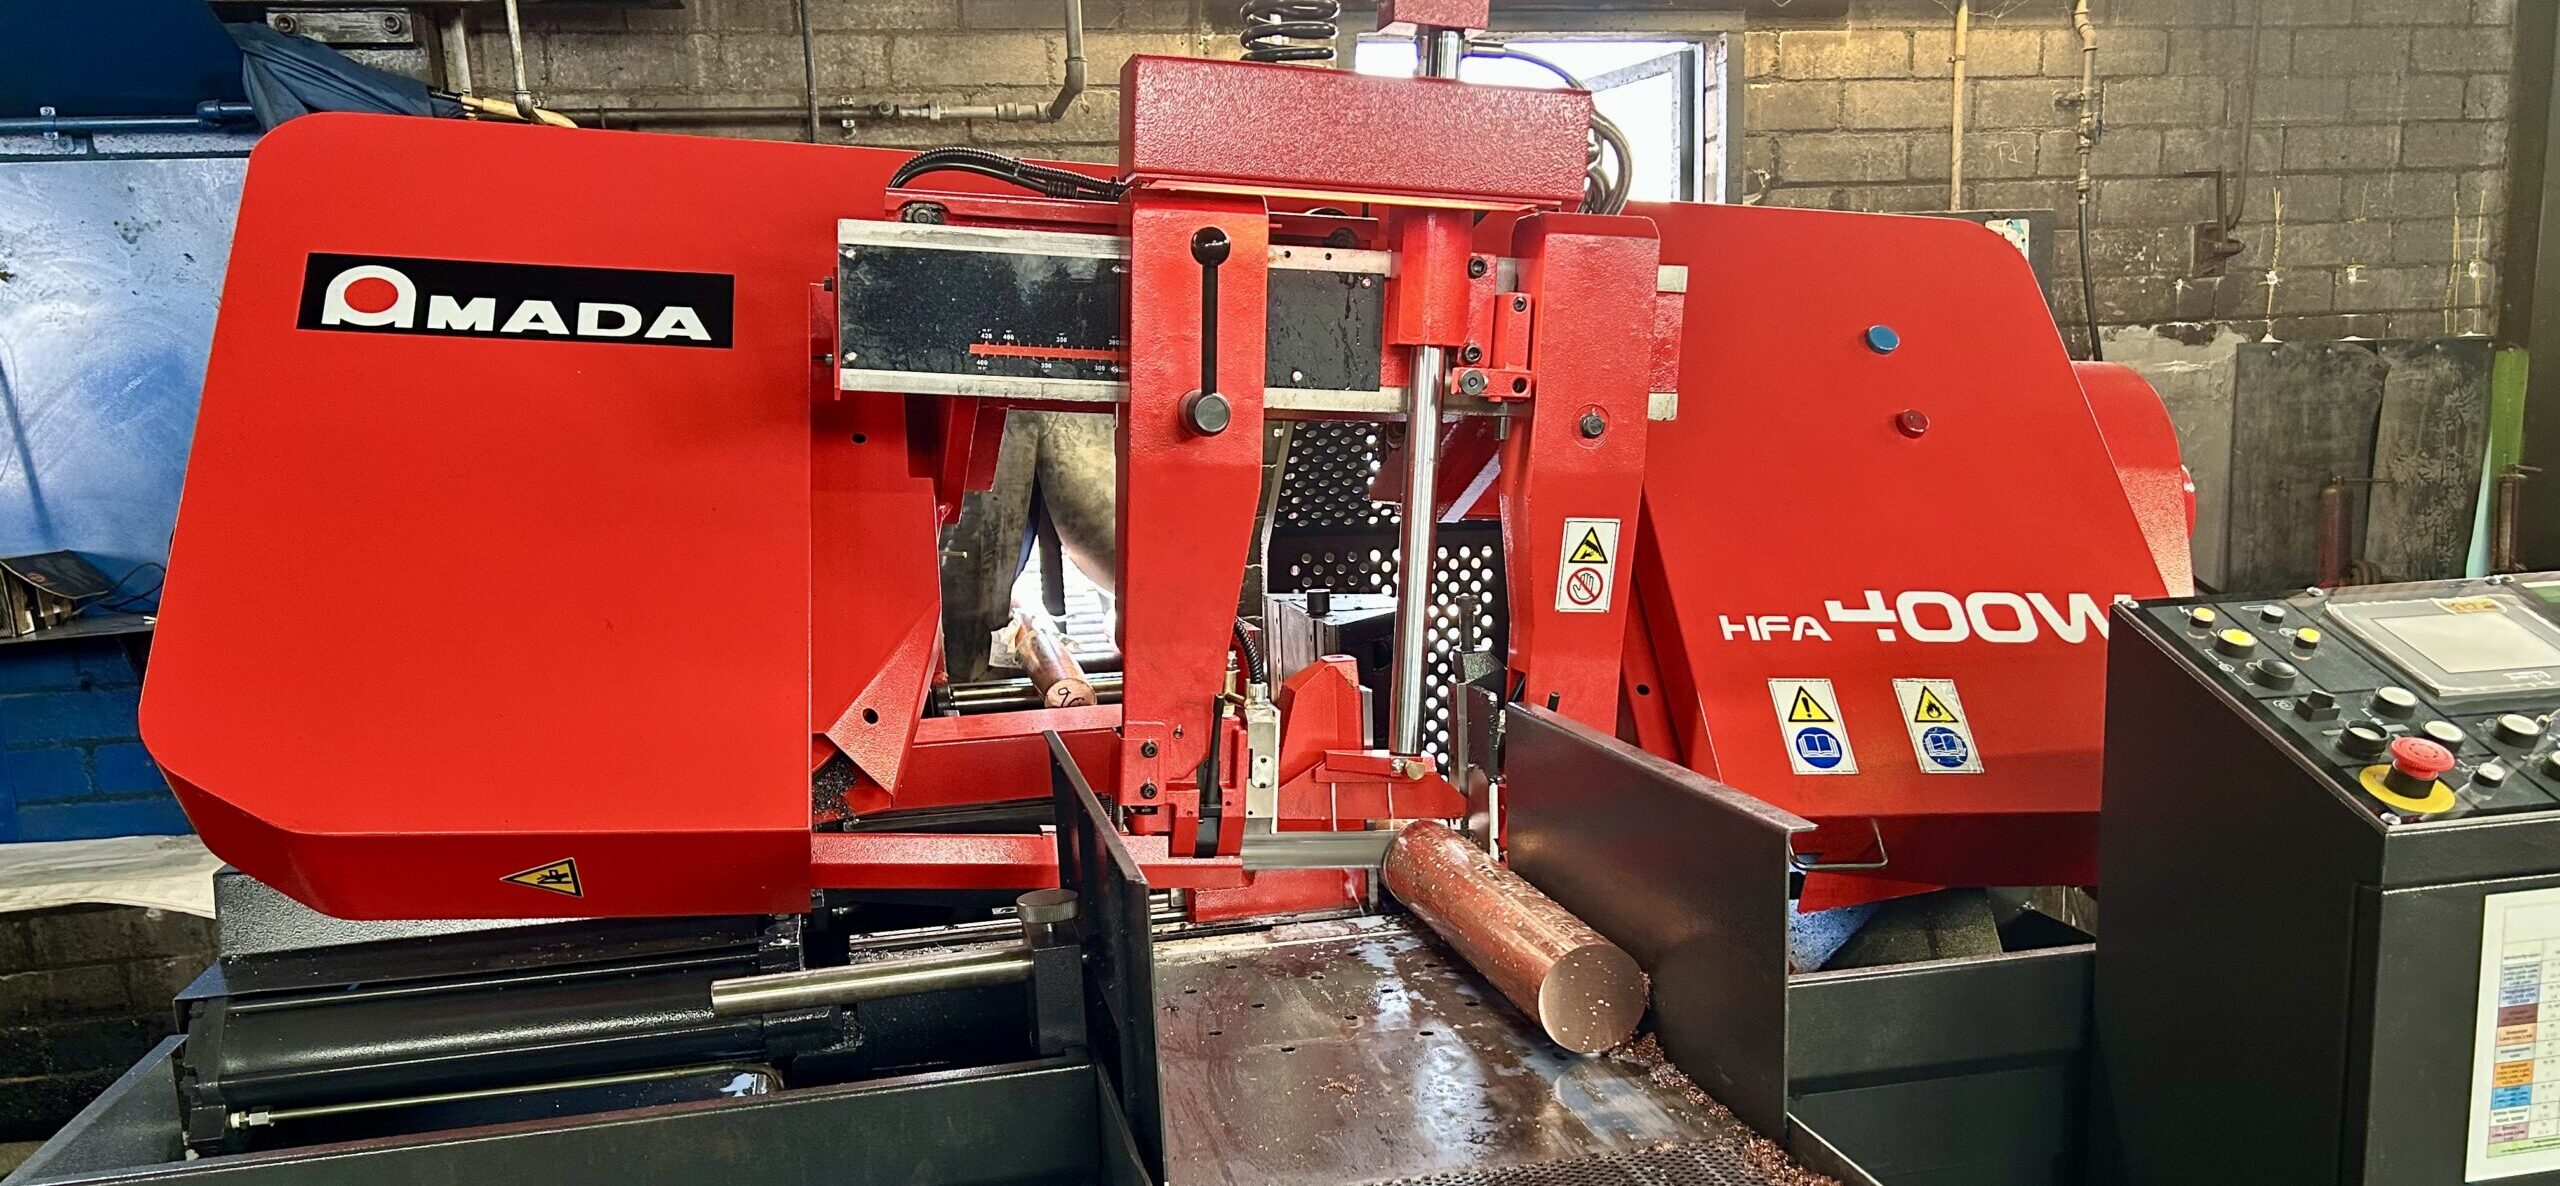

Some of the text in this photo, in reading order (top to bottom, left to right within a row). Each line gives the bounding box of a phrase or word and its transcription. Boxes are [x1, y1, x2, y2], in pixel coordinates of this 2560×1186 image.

[321, 265, 711, 340] AMADA
[1719, 590, 2131, 643] HFA 400W
